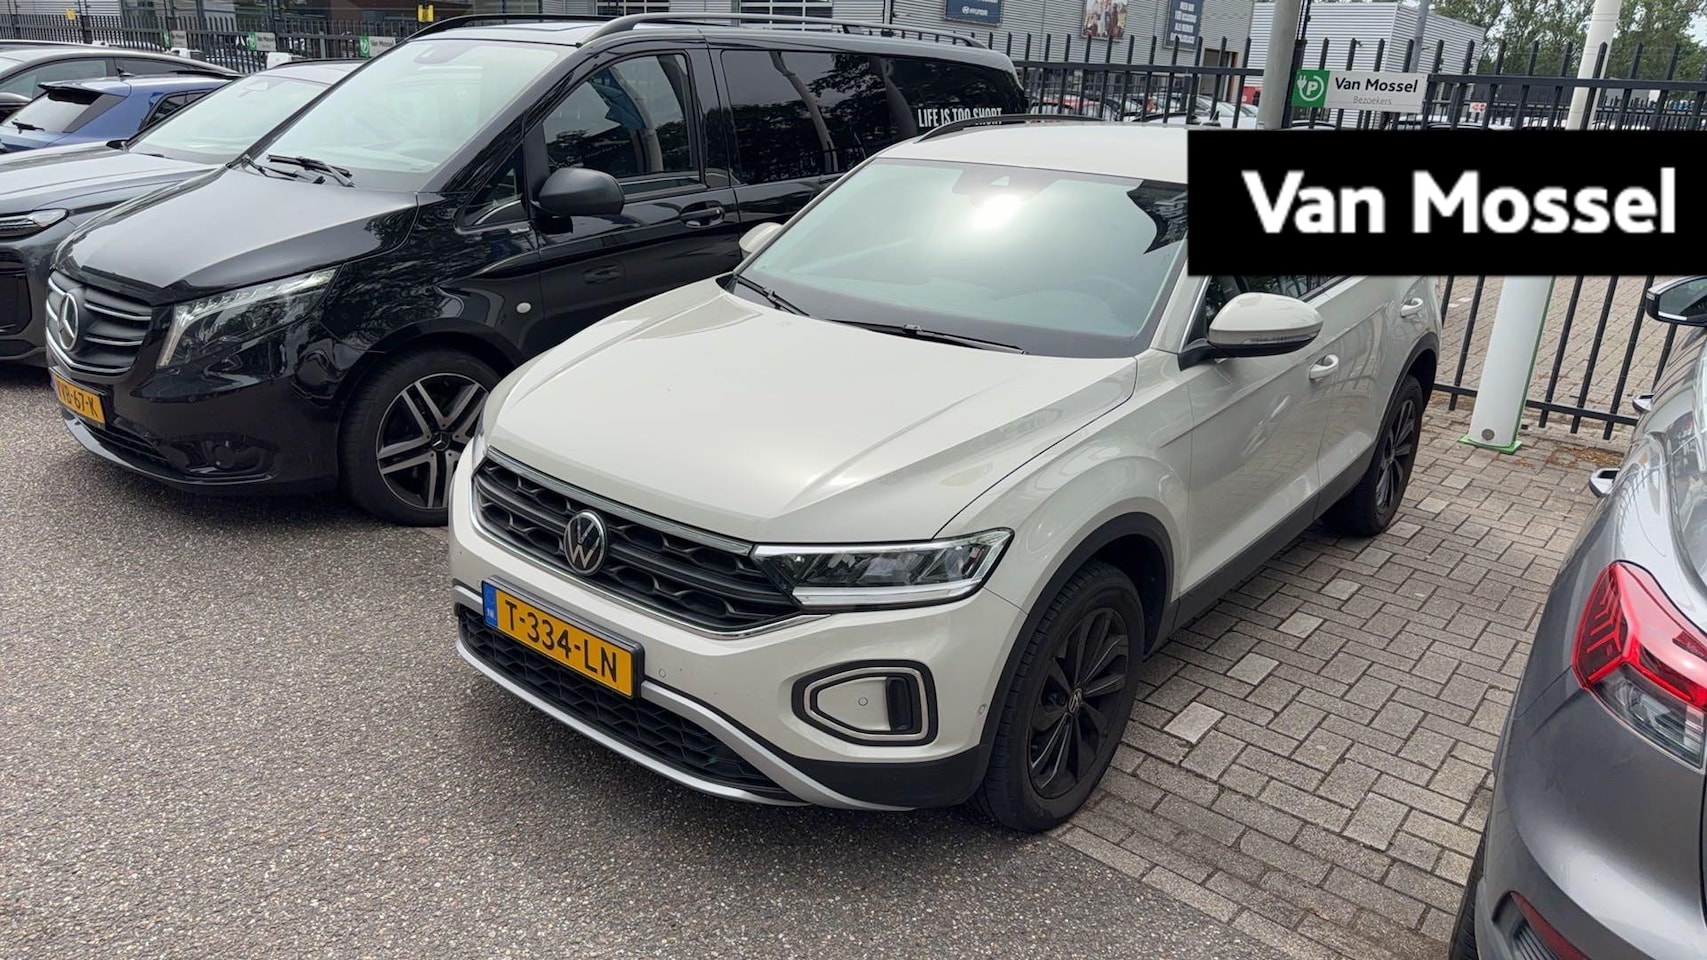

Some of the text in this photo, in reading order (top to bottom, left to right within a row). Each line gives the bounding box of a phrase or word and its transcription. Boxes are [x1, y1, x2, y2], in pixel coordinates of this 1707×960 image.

[1335, 77, 1419, 93] Van Mossel
[1353, 95, 1392, 106] Bezoekers
[917, 108, 939, 128] LIFE
[940, 107, 952, 125] IS
[951, 107, 971, 123] TOO
[504, 599, 617, 683] T-334-LN
